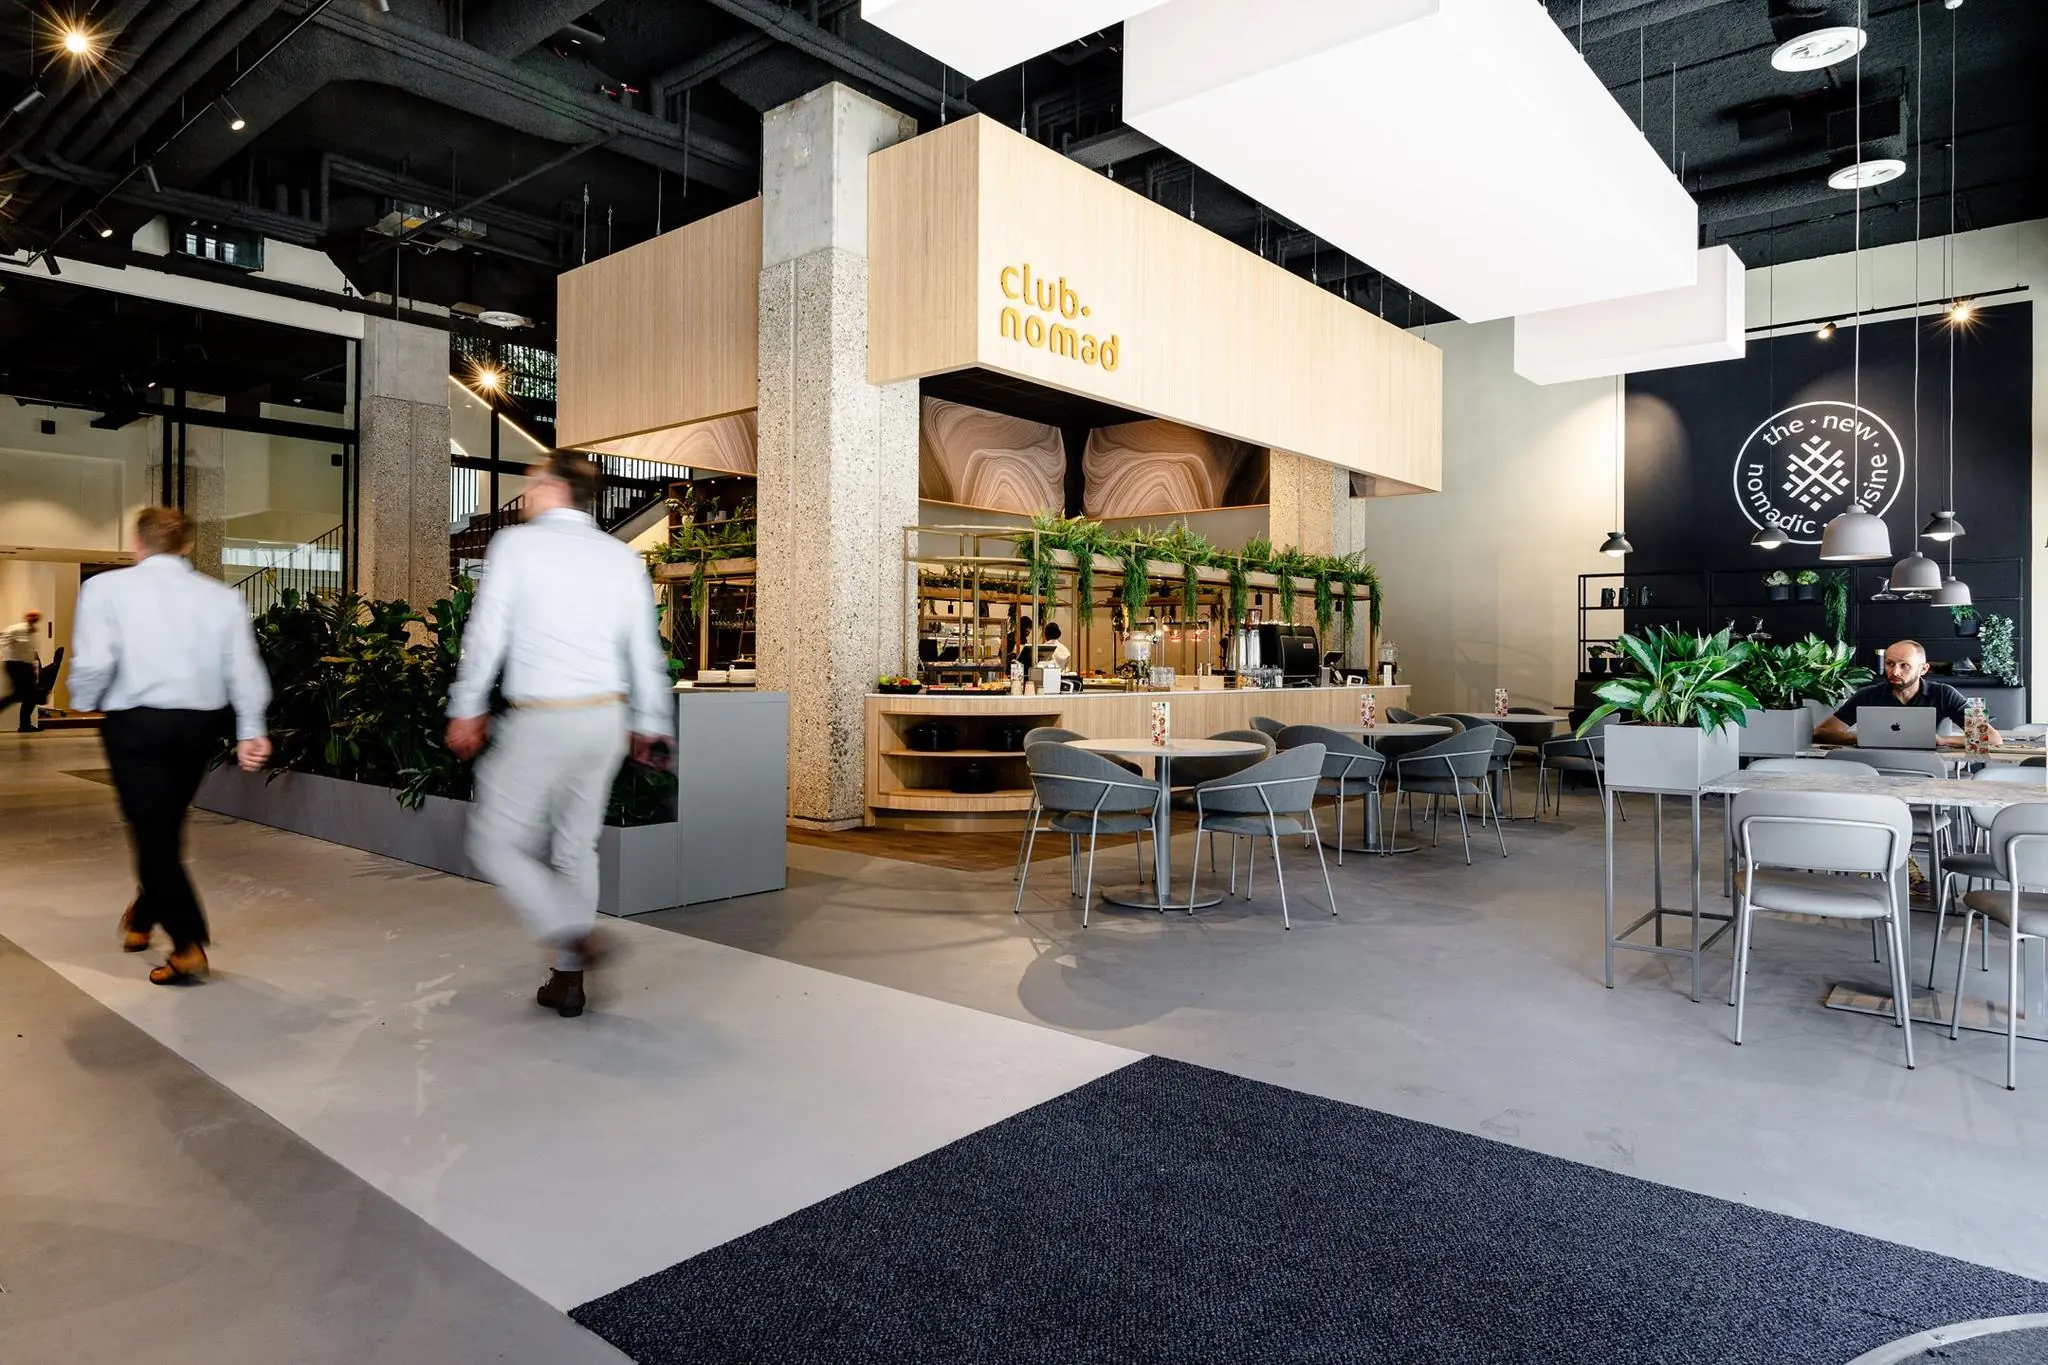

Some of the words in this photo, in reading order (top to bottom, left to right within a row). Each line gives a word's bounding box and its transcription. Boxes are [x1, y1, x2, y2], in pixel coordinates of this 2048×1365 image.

[1000, 263, 1091, 320] club.
[1000, 306, 1119, 372] nomad
[1762, 418, 1805, 446] the
[1822, 415, 1879, 441] new
[1747, 463, 1816, 534] nomadic
